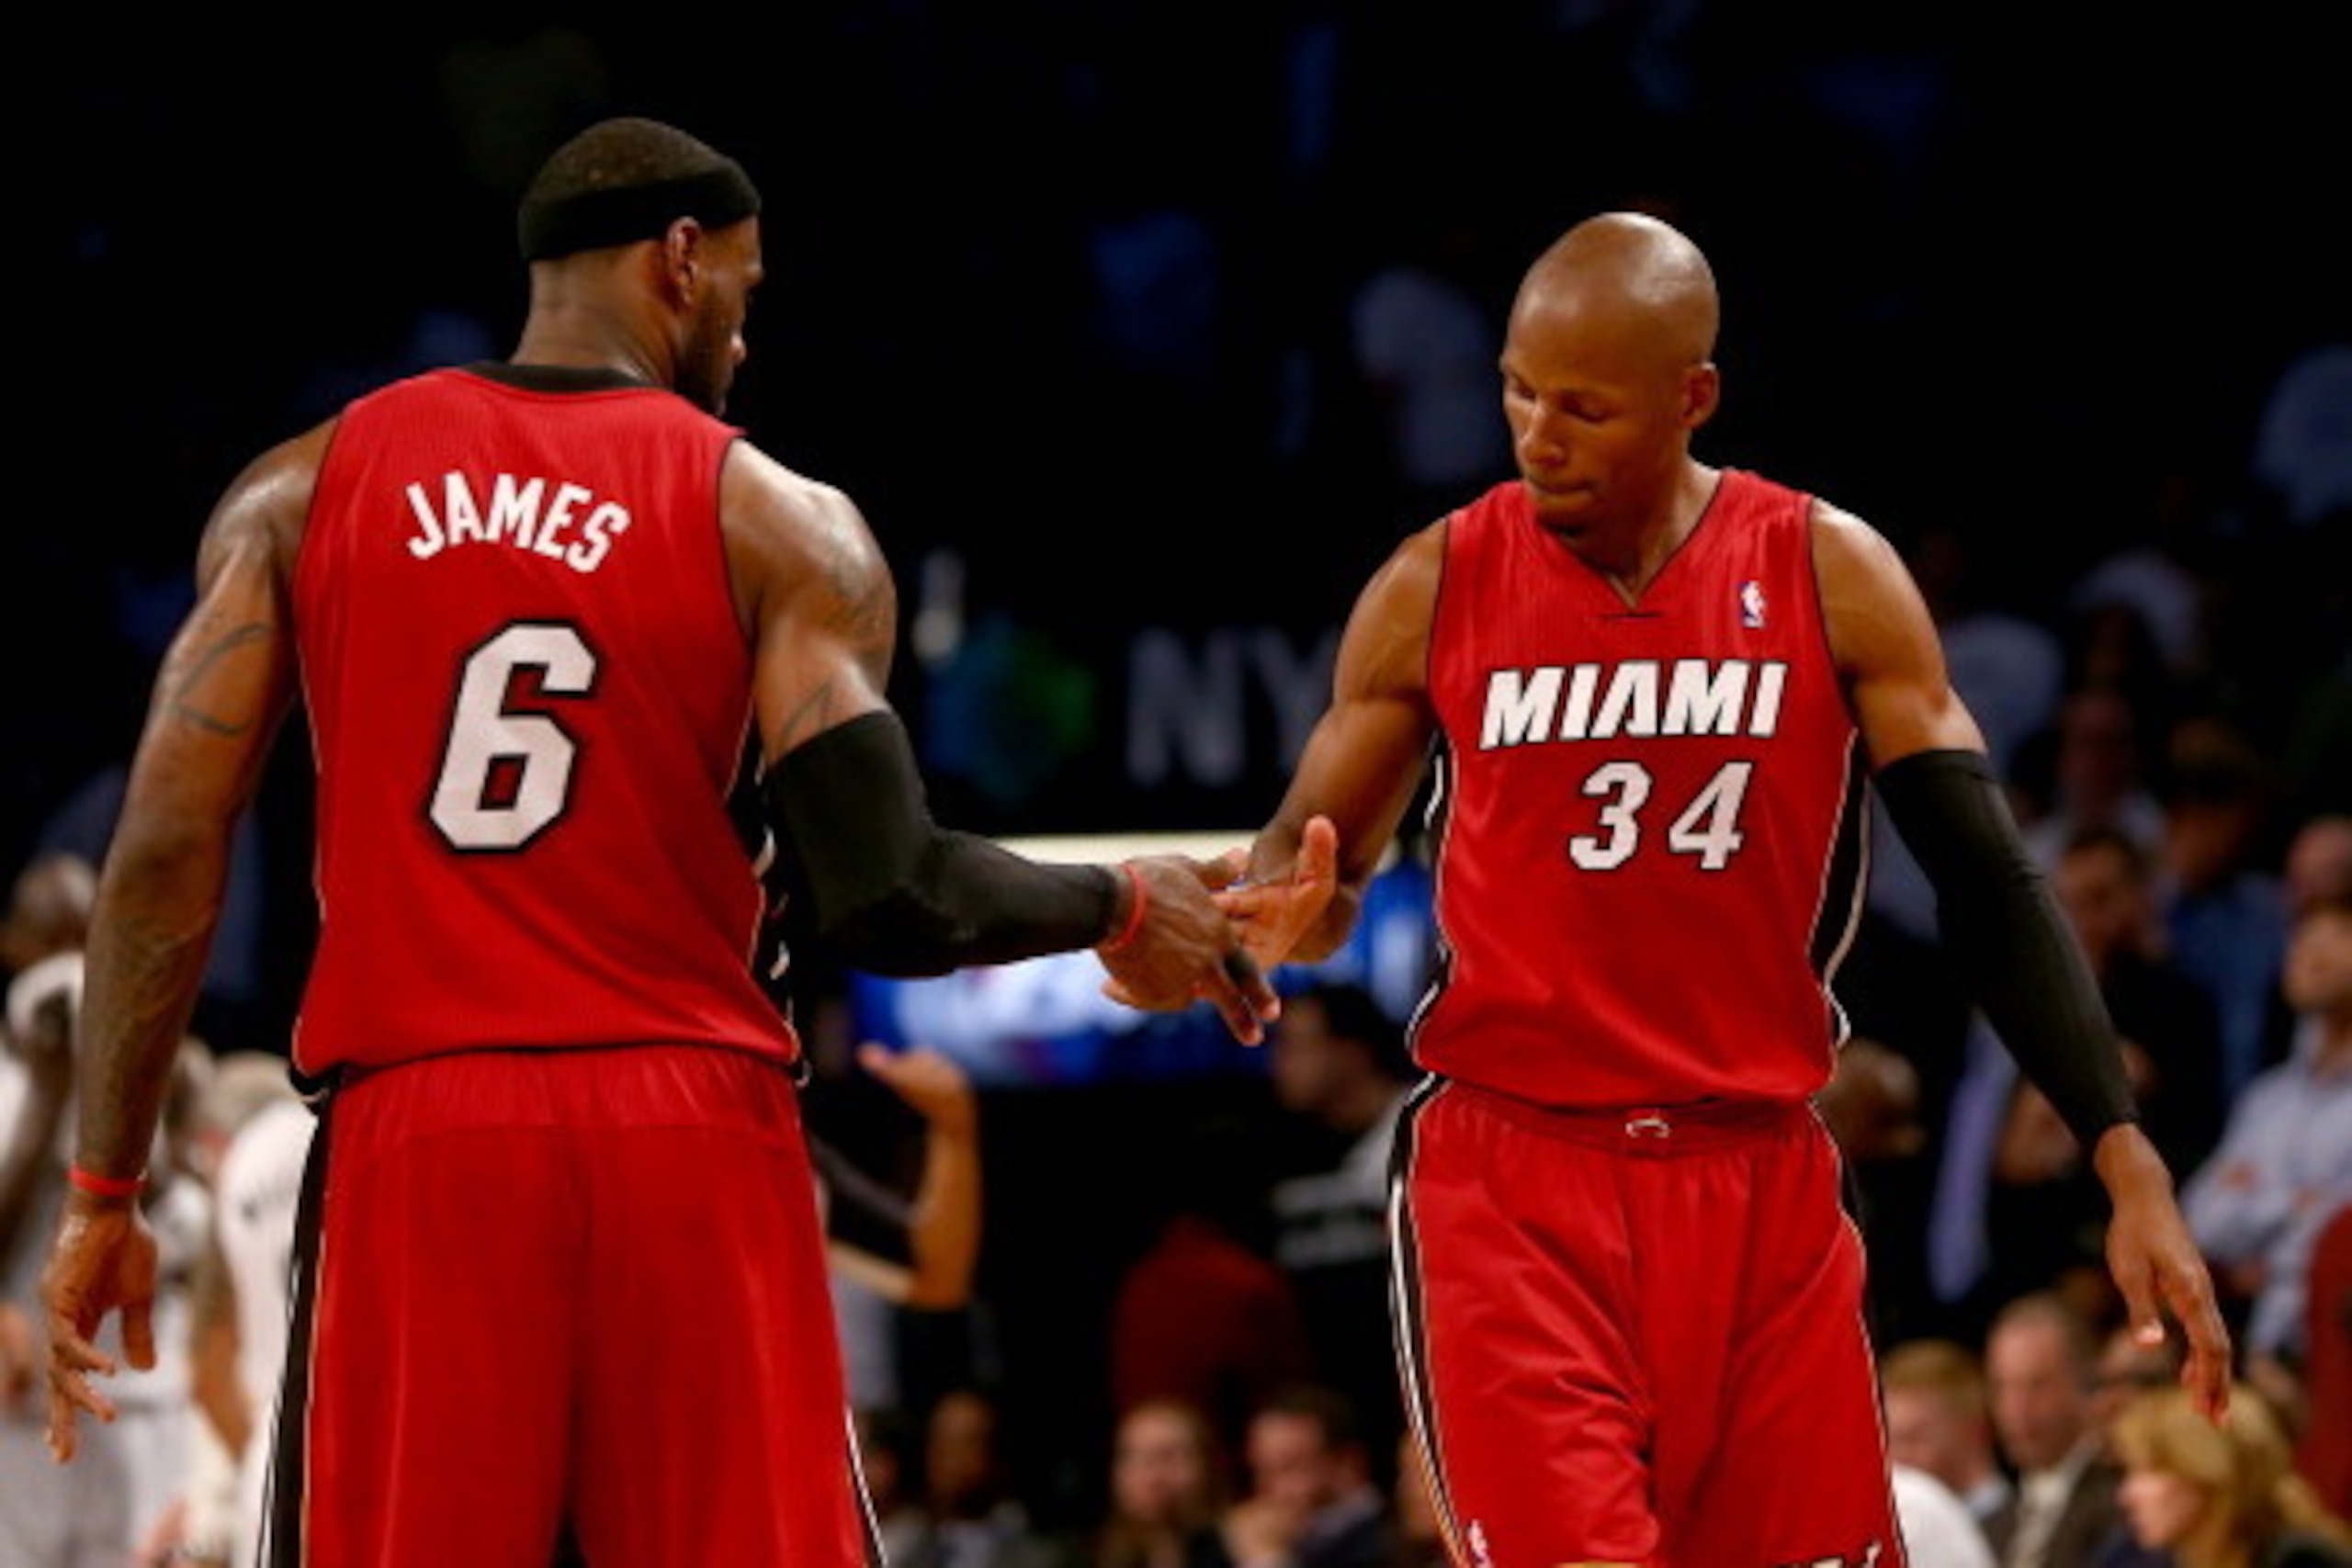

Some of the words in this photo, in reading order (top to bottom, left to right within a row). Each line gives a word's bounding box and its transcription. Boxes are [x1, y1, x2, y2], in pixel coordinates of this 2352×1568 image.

[405, 469, 631, 573] JAMES
[428, 620, 598, 851] 6
[1478, 659, 1788, 750] MIAMI
[1568, 761, 1753, 871] 34
